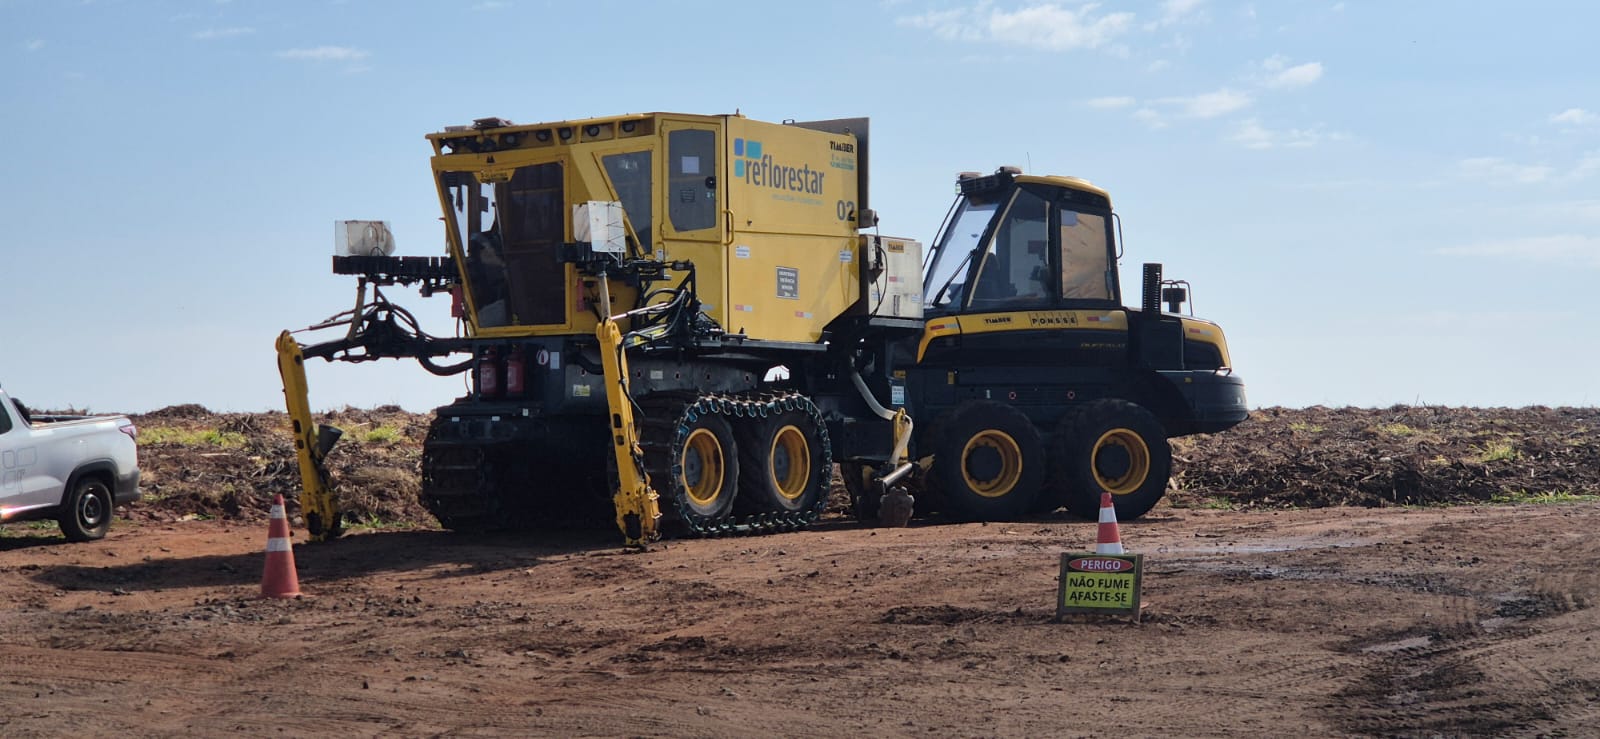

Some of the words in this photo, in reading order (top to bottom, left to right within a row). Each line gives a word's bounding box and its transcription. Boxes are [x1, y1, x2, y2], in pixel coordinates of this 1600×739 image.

[829, 140, 854, 153] TIMBER
[745, 154, 825, 195] reflorestar
[837, 199, 857, 221] 02
[1031, 317, 1077, 325] PONSSE
[1081, 560, 1121, 570] PERIGO
[1069, 576, 1095, 588] NÃO
[1098, 578, 1130, 589] FUME
[1069, 591, 1127, 602] AFASTE-SE
